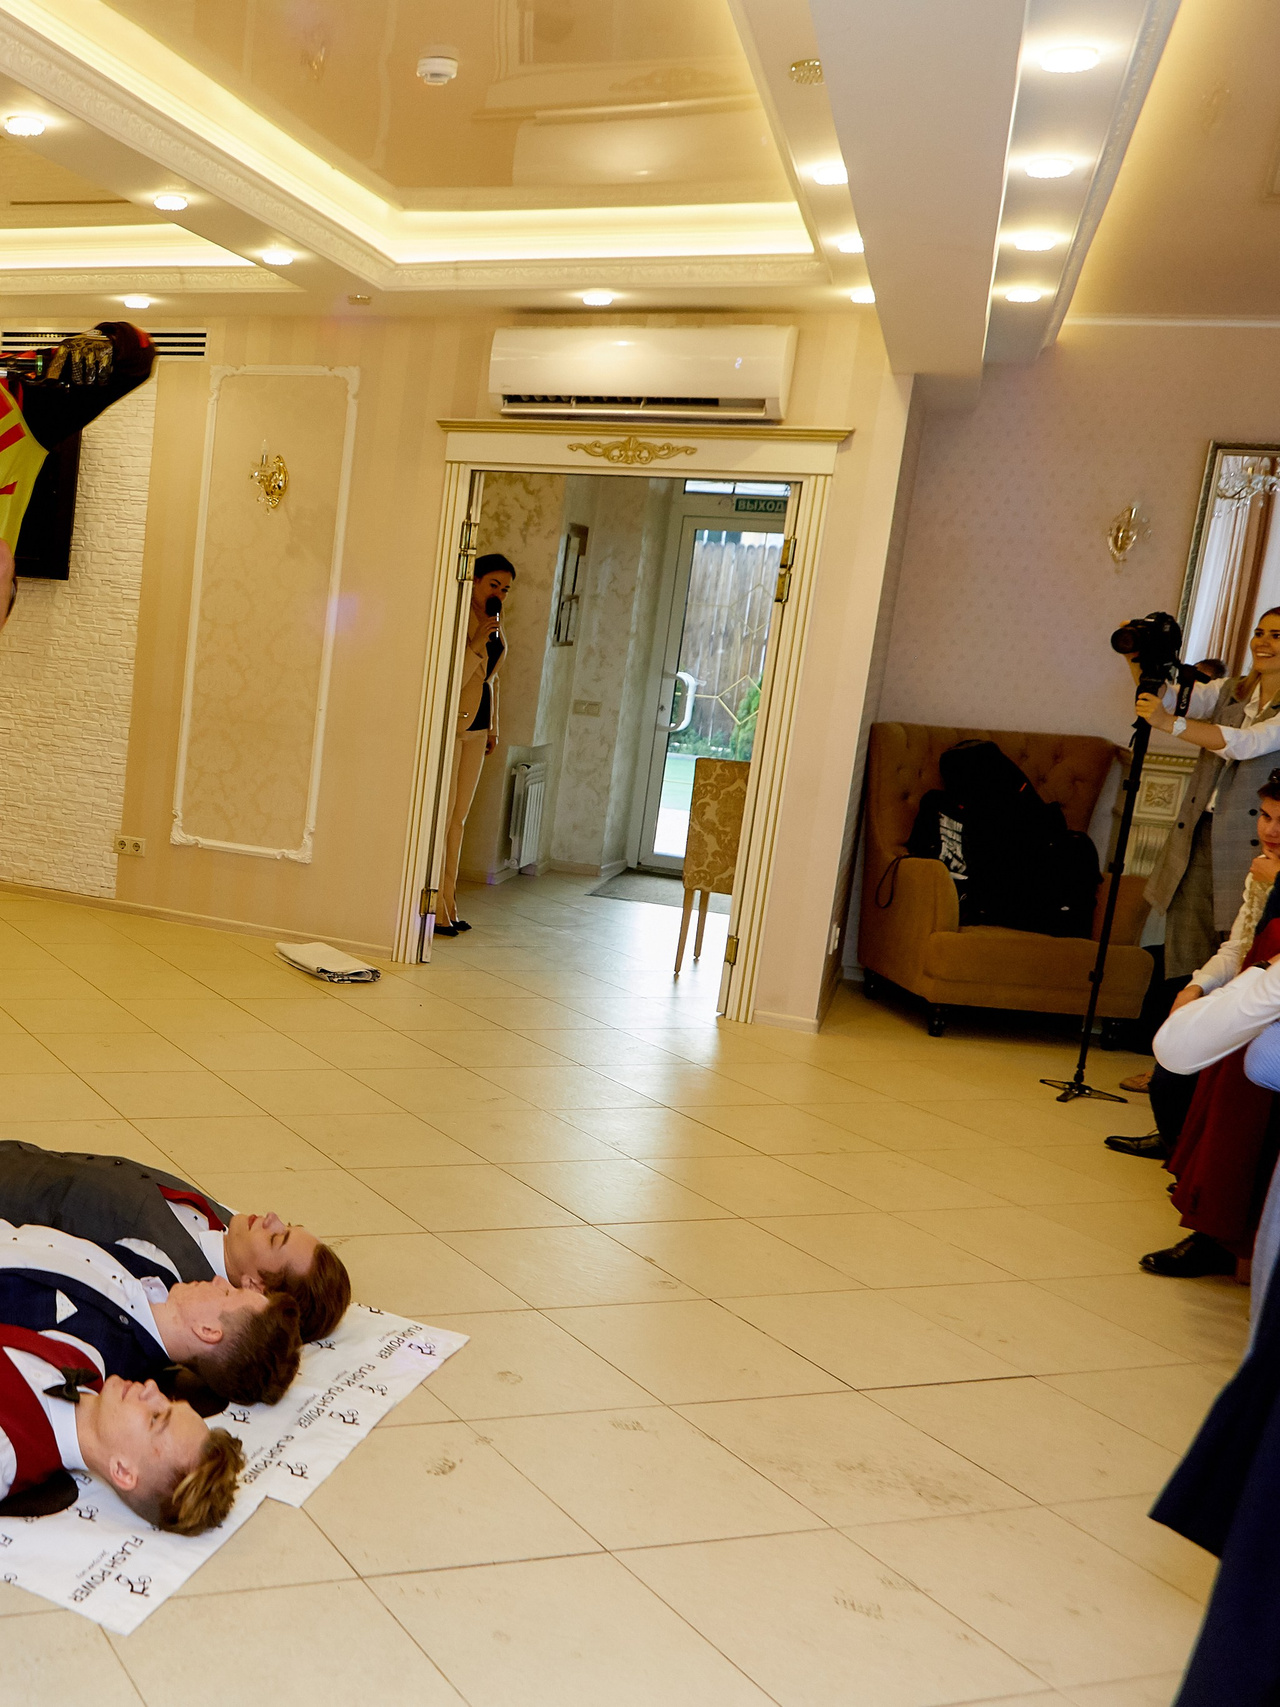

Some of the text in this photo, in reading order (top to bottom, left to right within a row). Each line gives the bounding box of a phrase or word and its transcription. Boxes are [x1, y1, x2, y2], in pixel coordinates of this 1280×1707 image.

[737, 500, 786, 512] ВЫХОД
[376, 1336, 406, 1360] POWER
[295, 1405, 325, 1430] POWER
[104, 1534, 144, 1570] FLASH
[68, 1567, 113, 1604] POWER
